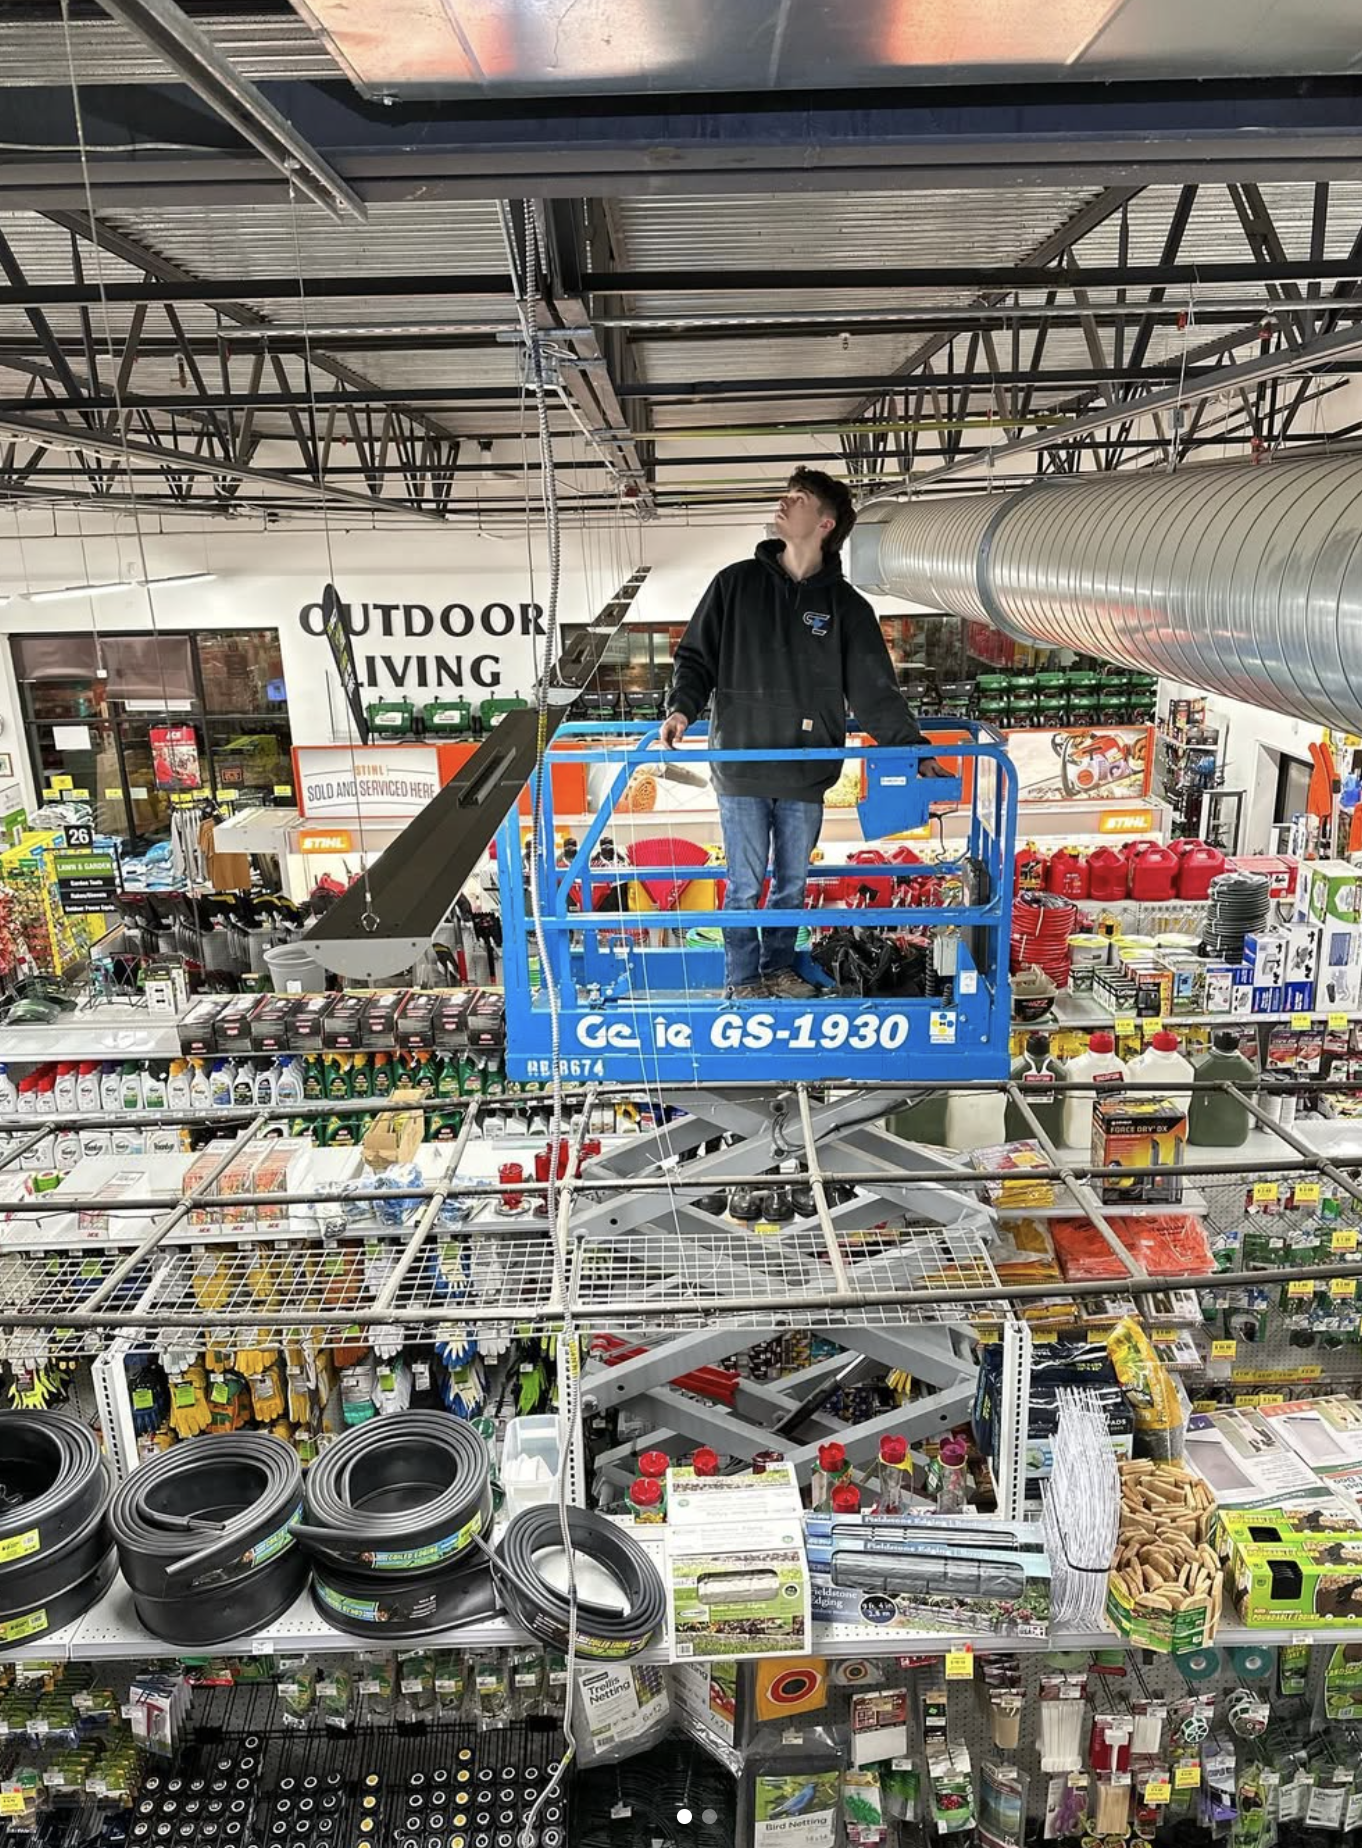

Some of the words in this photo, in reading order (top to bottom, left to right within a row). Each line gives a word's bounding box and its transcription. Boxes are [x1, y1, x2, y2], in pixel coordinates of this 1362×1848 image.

[299, 602, 548, 638] OUTDOOR
[354, 764, 386, 776] STIHL
[307, 783, 334, 802] SOLD
[336, 780, 357, 798] AND
[359, 779, 408, 798] SERVICED
[410, 782, 436, 799] HERE
[69, 828, 90, 845] 26
[302, 836, 346, 849] STIHL
[84, 862, 111, 870] GARDEN
[709, 1013, 909, 1050] GS-1930
[864, 1515, 912, 1525] Fieldstone
[914, 1517, 947, 1527] Edging
[866, 1542, 915, 1552] Fieldstone
[917, 1544, 951, 1556] Edging
[588, 1676, 620, 1696] Trellis
[589, 1679, 631, 1705] Netting
[765, 1821, 787, 1831] Bird
[788, 1817, 827, 1829] Netting
